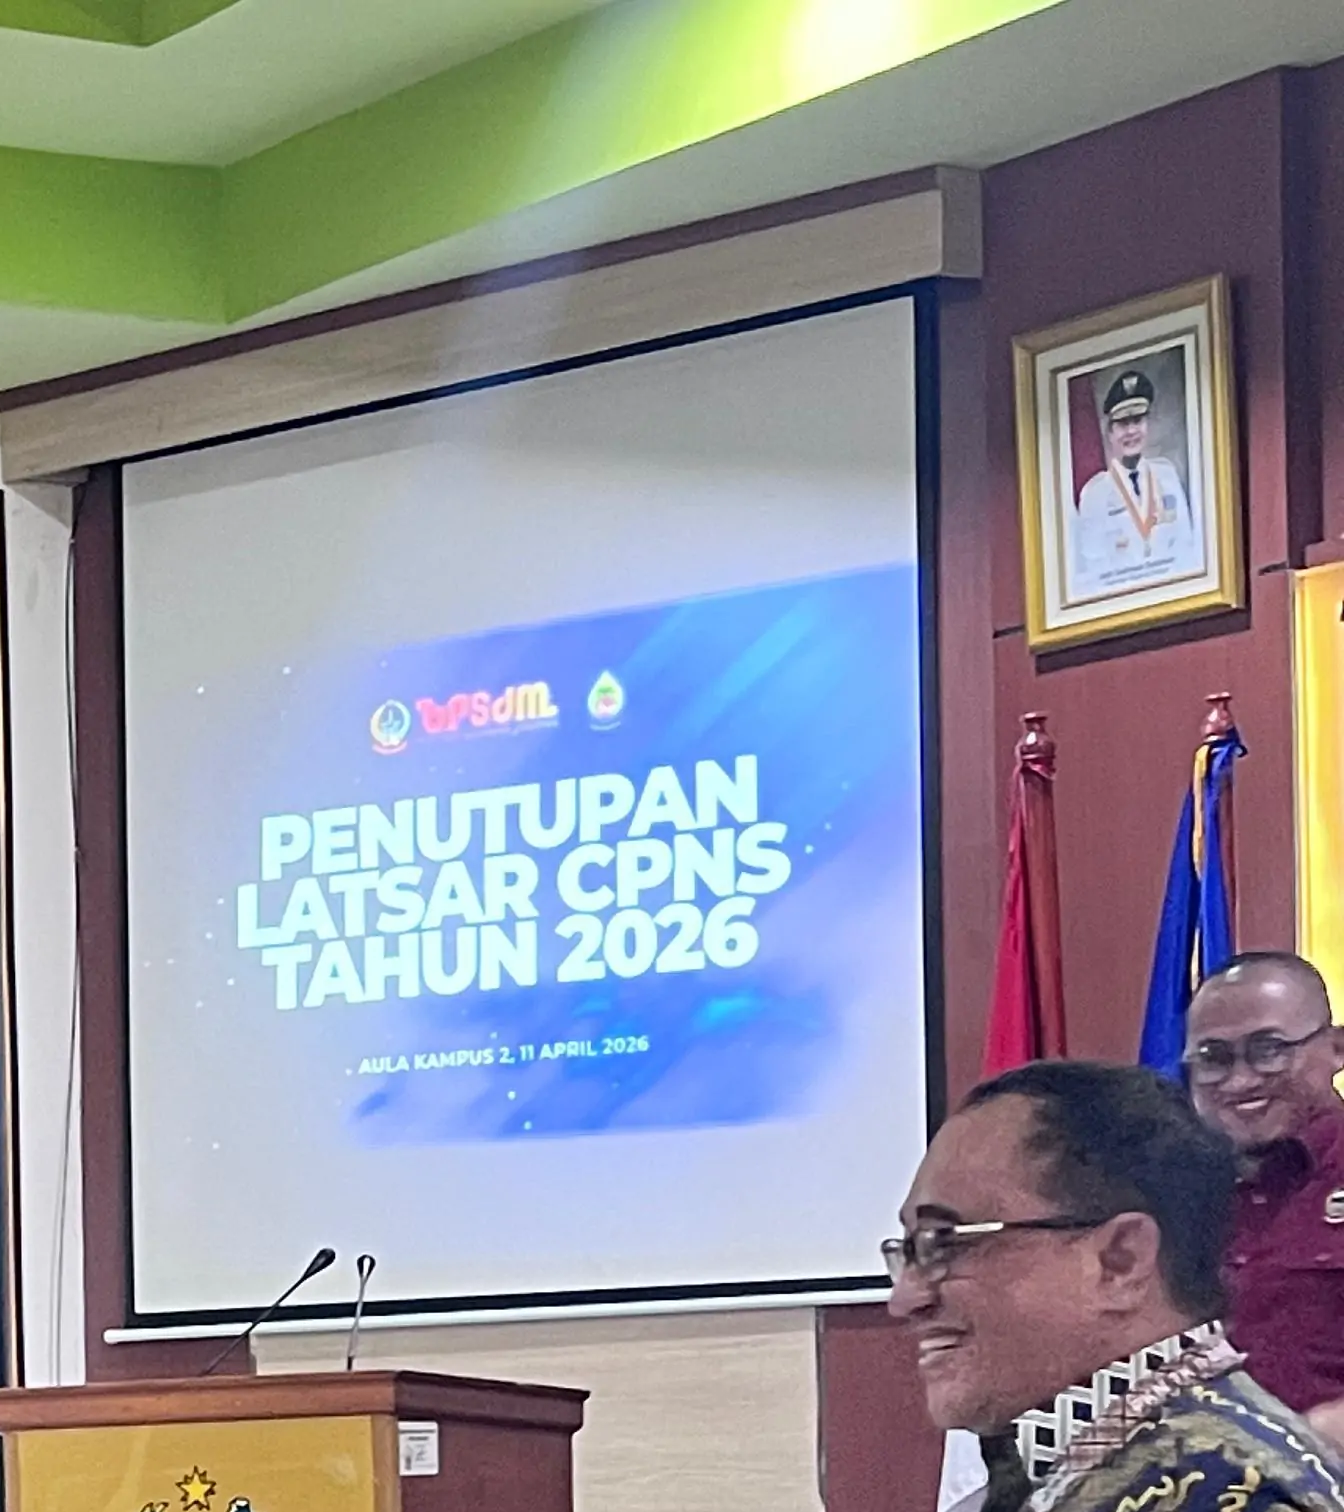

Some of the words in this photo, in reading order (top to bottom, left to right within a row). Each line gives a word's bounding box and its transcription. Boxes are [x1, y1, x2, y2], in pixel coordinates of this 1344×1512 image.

[261, 754, 758, 881] PENUTUPAN
[237, 853, 540, 949] LATSAR
[556, 822, 792, 912] CPNS
[261, 920, 538, 1010] TAHUN
[554, 895, 759, 983] 2026
[357, 1055, 410, 1075] AULA
[414, 1047, 495, 1071] KAMPUS
[519, 1043, 535, 1062] 11
[538, 1039, 598, 1060] APRIL
[601, 1035, 650, 1056] 2026
